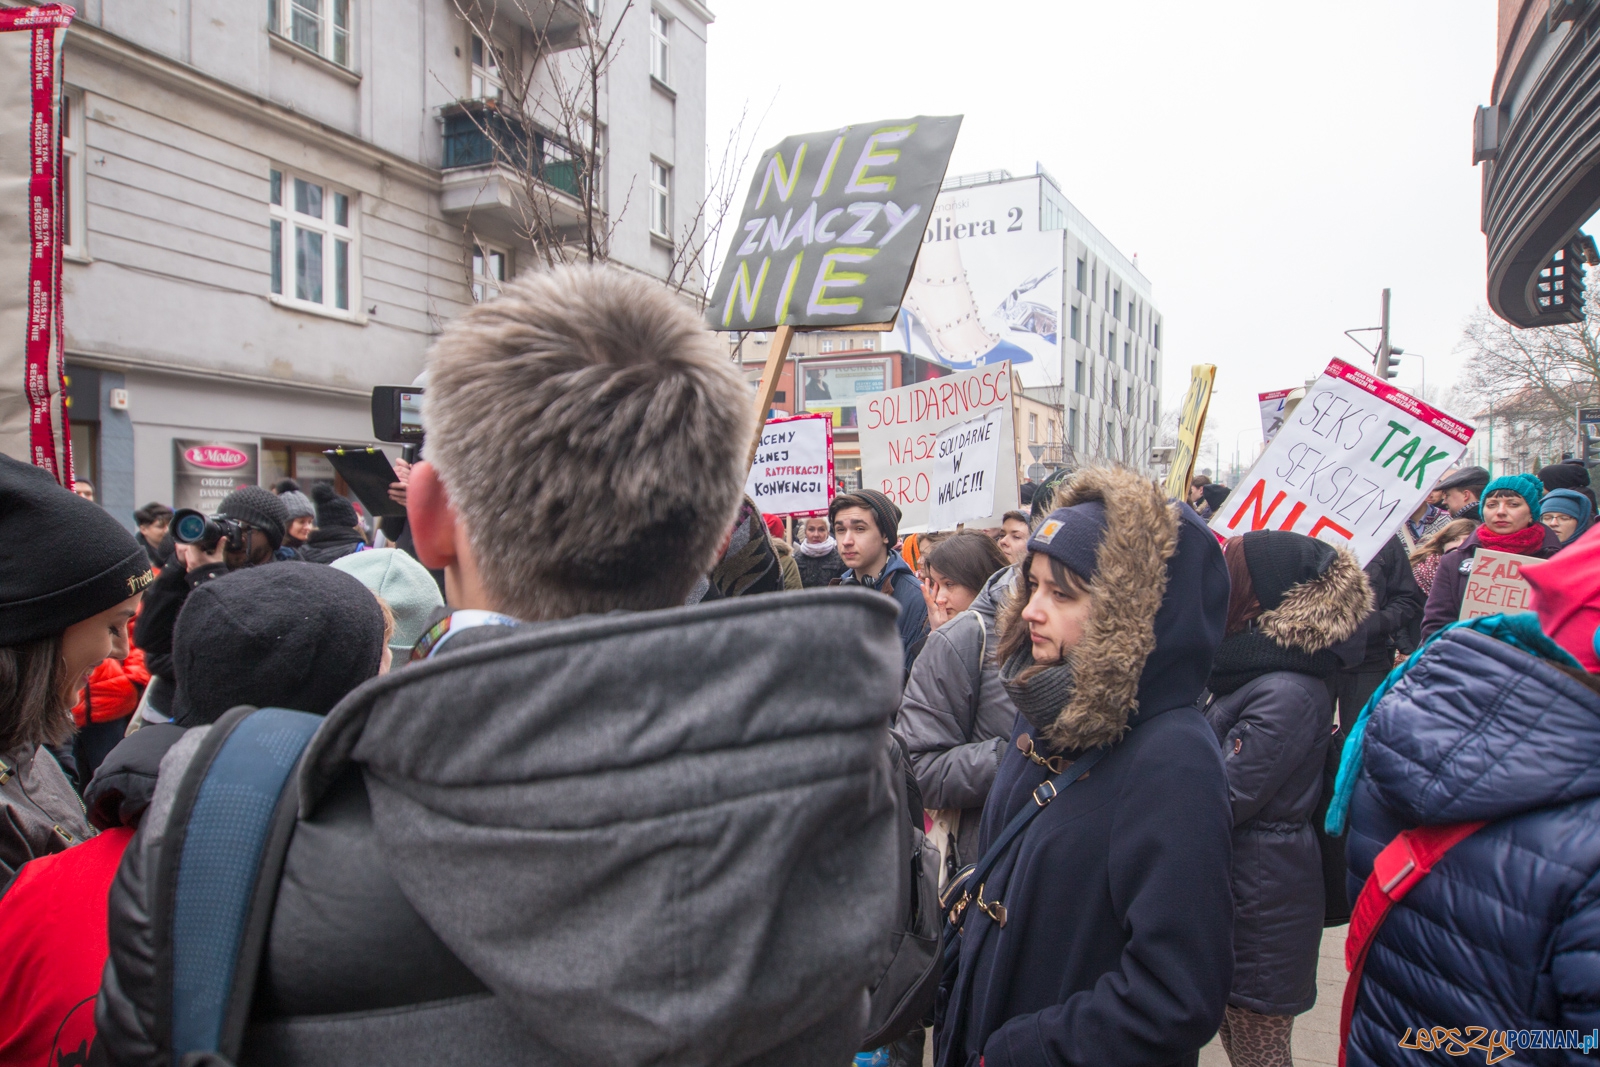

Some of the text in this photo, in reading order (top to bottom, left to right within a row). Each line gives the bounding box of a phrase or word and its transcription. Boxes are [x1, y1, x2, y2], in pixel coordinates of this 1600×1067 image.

[13, 15, 71, 25] SEKSIZM NIE
[35, 28, 43, 89] SEKSIZM NIE
[35, 112, 43, 174] SEKSIZM NIE
[755, 122, 918, 210] NIE
[34, 196, 43, 258] SEKSIZM NIE
[736, 200, 921, 256] ZNACZY
[1007, 206, 1024, 233] 2
[722, 247, 880, 327] NIE
[31, 280, 41, 341] SEKSIZM NIE
[29, 363, 41, 405] SEKSIZM
[37, 374, 45, 396] SEKS
[1345, 372, 1378, 391] SEKSIZM NIE
[1354, 371, 1375, 384] SEKS TAK
[1385, 393, 1422, 415] SEKSIZM NIE
[1395, 392, 1419, 407] SEKS TAK
[1431, 418, 1470, 442] SEKSIZM NIE
[1441, 417, 1467, 434] SEKS TAK
[938, 422, 993, 458] SOLIDARNE
[1299, 391, 1449, 490] SEKS TAK
[765, 465, 824, 477] RATYFIKACJI
[953, 452, 963, 475] W
[201, 477, 234, 487] ODZIEŻ
[755, 480, 821, 496] KONWENCJI
[1276, 442, 1401, 537] SEKSIZM
